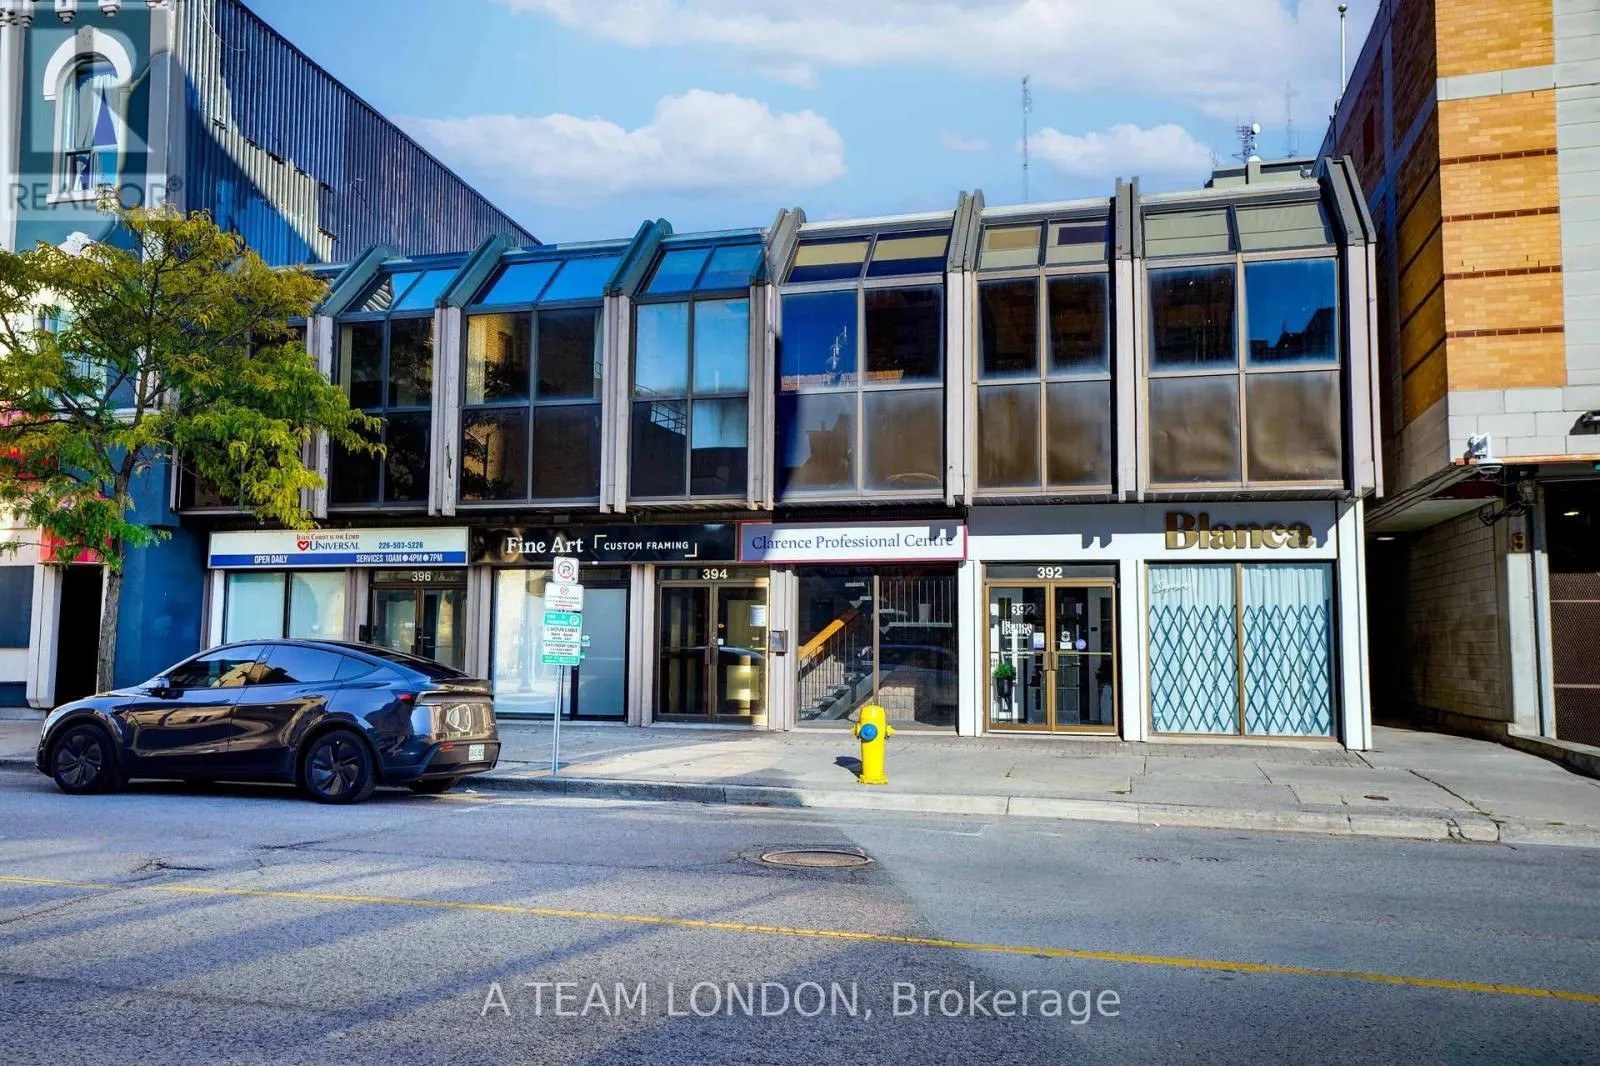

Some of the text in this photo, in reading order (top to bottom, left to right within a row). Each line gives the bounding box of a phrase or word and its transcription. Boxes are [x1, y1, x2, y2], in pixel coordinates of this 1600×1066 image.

[1164, 512, 1315, 549] Blanca
[310, 540, 360, 551] UNIVERSAL
[378, 541, 424, 549] 226-503-5226
[506, 536, 584, 554] Fine Art
[604, 541, 690, 550] CUSTOM FRAMING
[752, 532, 954, 550] Clarence Professional Centre
[254, 554, 288, 564] OPEN DAILY
[356, 554, 384, 562] SERVICES
[411, 570, 432, 582] 396
[702, 568, 728, 580] 394
[1037, 566, 1063, 579] 392
